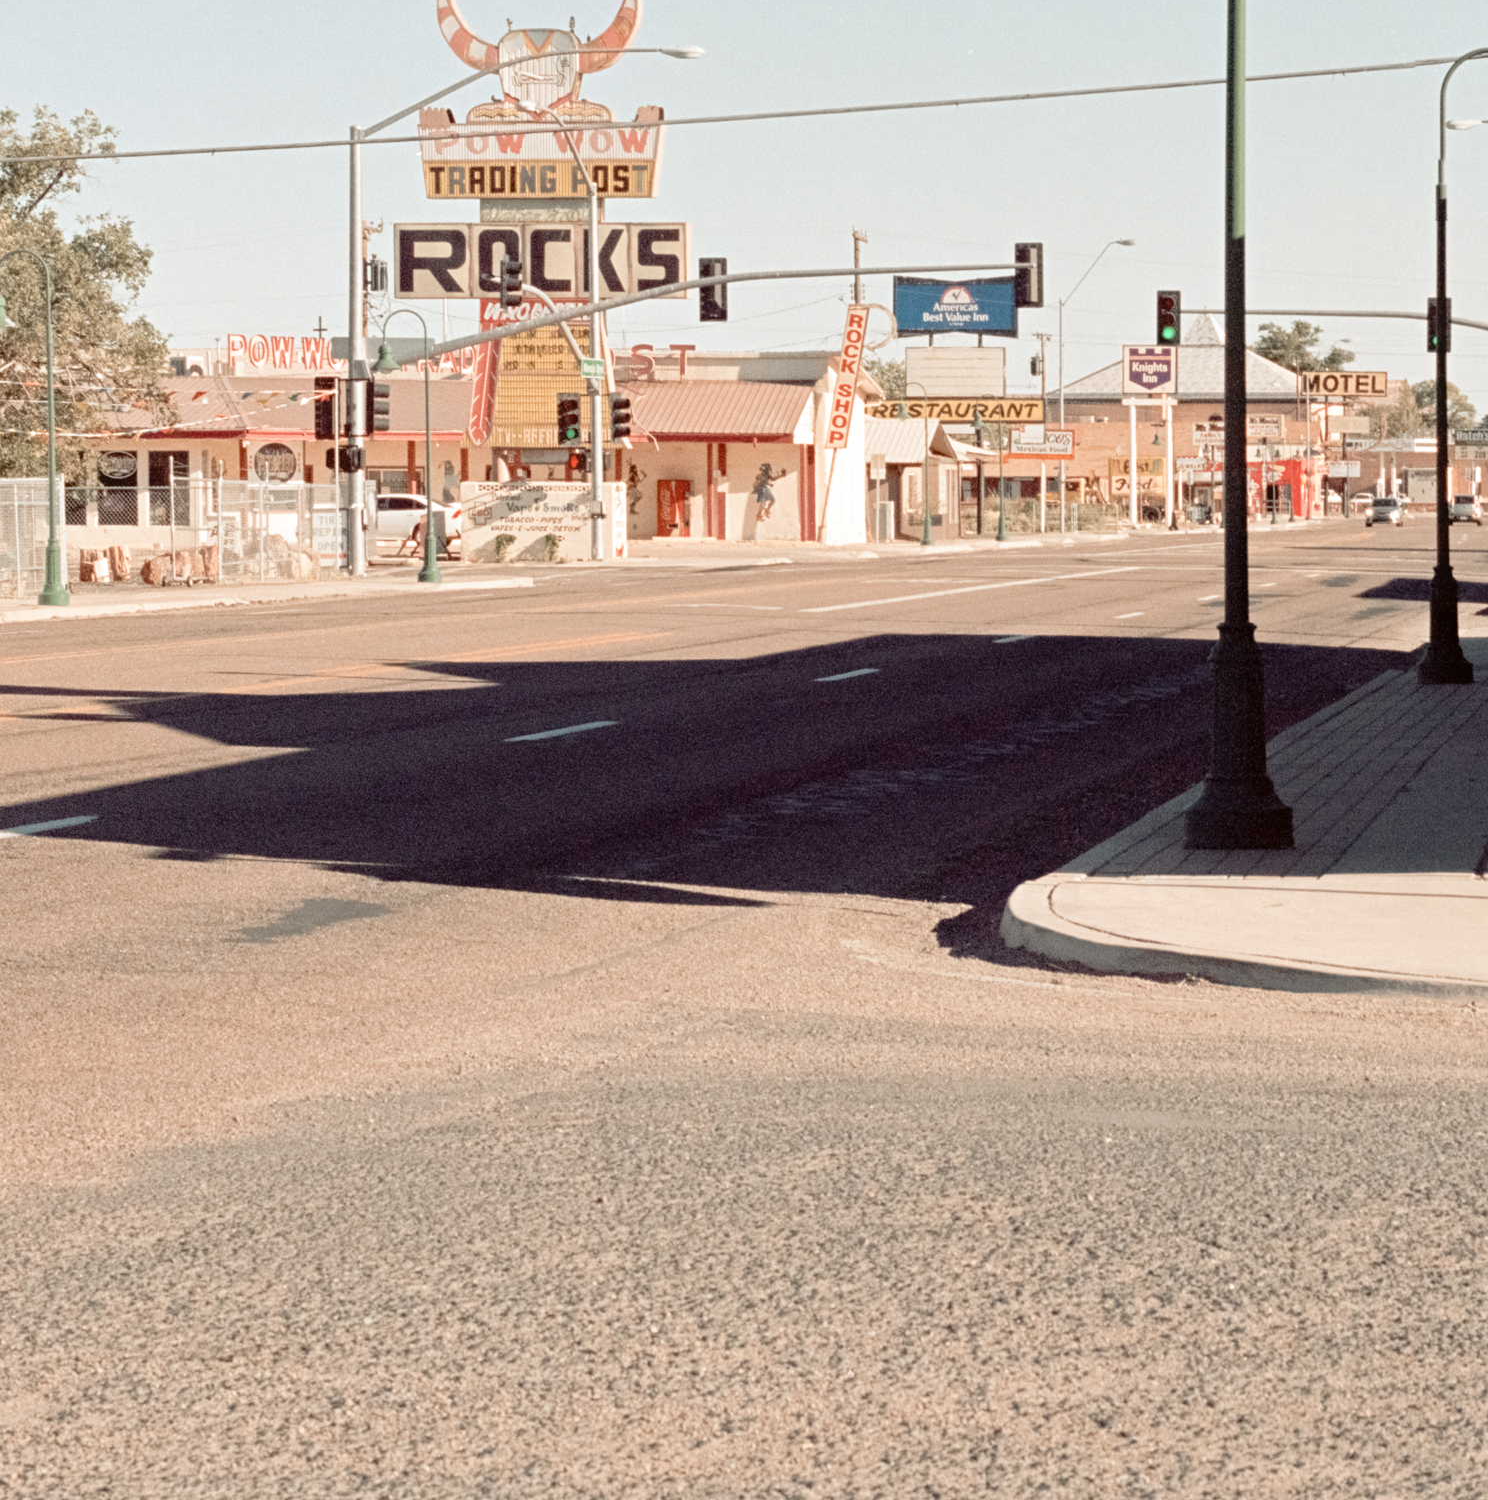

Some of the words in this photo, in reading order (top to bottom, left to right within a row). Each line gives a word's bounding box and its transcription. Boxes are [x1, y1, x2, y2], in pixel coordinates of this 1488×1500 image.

[428, 129, 525, 155] POW
[553, 128, 650, 155] WOW
[429, 165, 557, 195] TRADING
[571, 164, 648, 194] POST
[399, 228, 680, 293] ROCKS
[922, 312, 943, 322] Best
[945, 312, 972, 322] Value
[973, 312, 988, 322] Inn
[932, 303, 978, 312] Americas
[227, 334, 293, 369] POW
[840, 314, 864, 374] ROCK
[1131, 362, 1168, 375] Knights
[1142, 374, 1158, 383] Inn
[1303, 374, 1385, 394] MOTEL
[829, 383, 852, 444] SHOP
[872, 403, 1039, 418] RESTAURANT
[1015, 445, 1048, 453] Mexican
